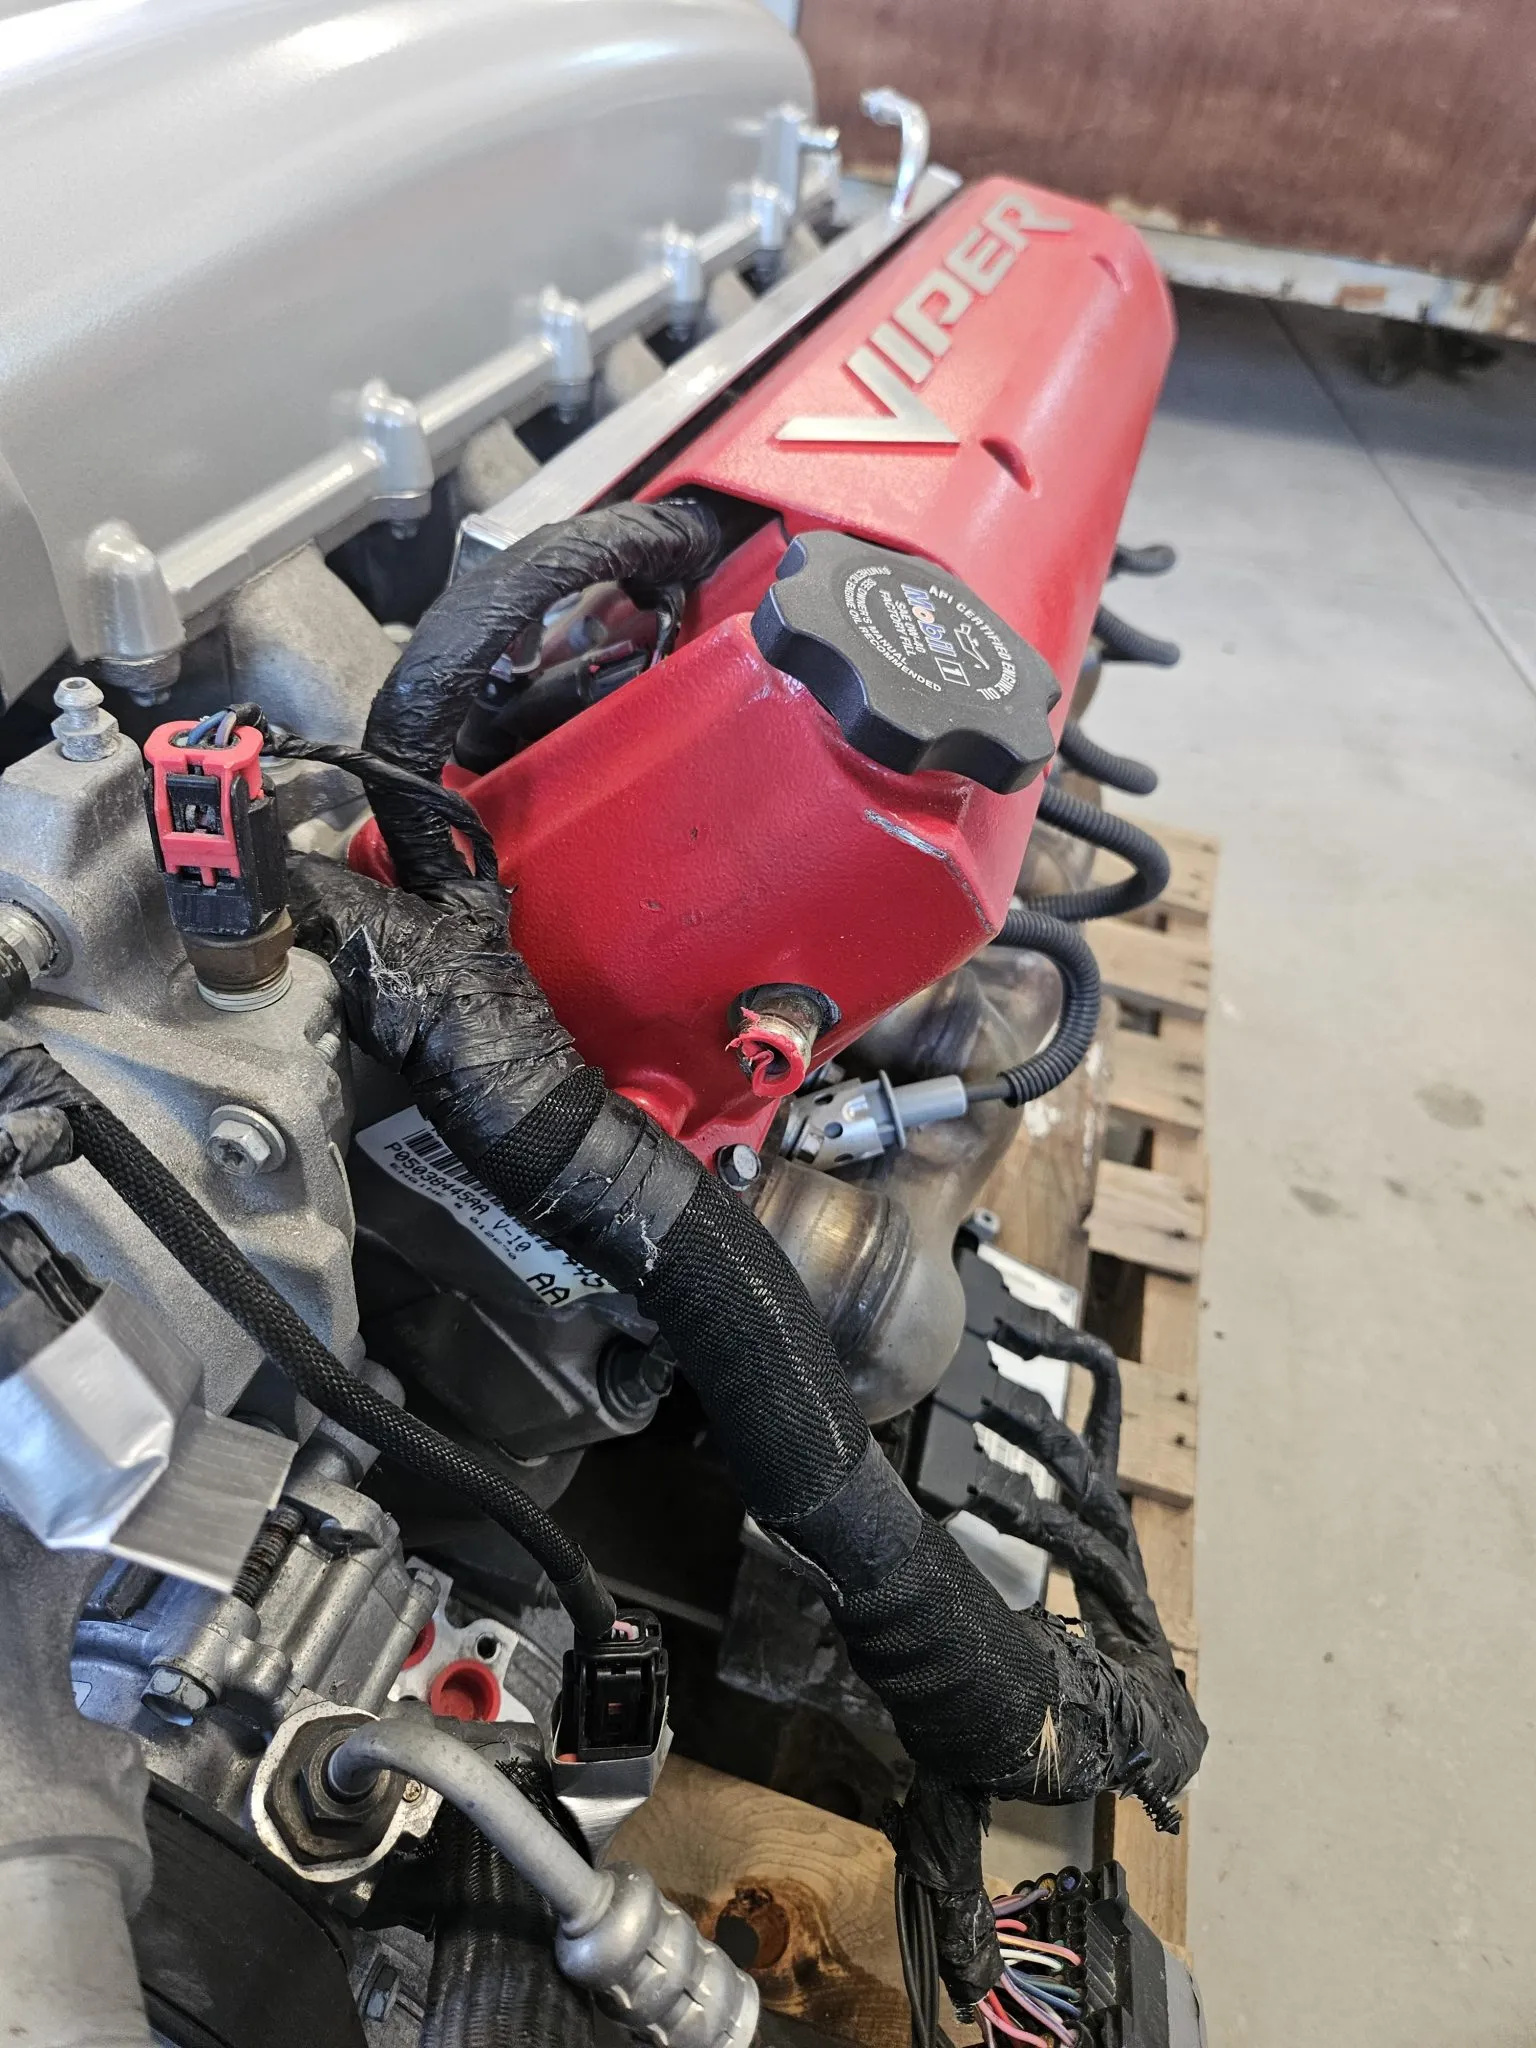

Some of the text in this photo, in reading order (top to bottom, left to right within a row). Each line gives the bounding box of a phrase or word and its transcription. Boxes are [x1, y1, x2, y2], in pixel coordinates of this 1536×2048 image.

[775, 194, 1074, 444] VIPER
[849, 609, 862, 624] OIL
[859, 626, 942, 692] RECOMMENDED
[856, 577, 907, 665] SEE OWNER'S MANUAL
[879, 589, 916, 656] FACTORY FILL
[895, 600, 926, 653] SAE 0W-40
[901, 583, 957, 657] Mobil
[929, 585, 1016, 700] API CERTIFIED ENGINE OIL
[384, 1141, 531, 1252] P05038445AA V-10
[390, 1162, 444, 1198] ENGINE
[526, 1272, 570, 1305] AA
